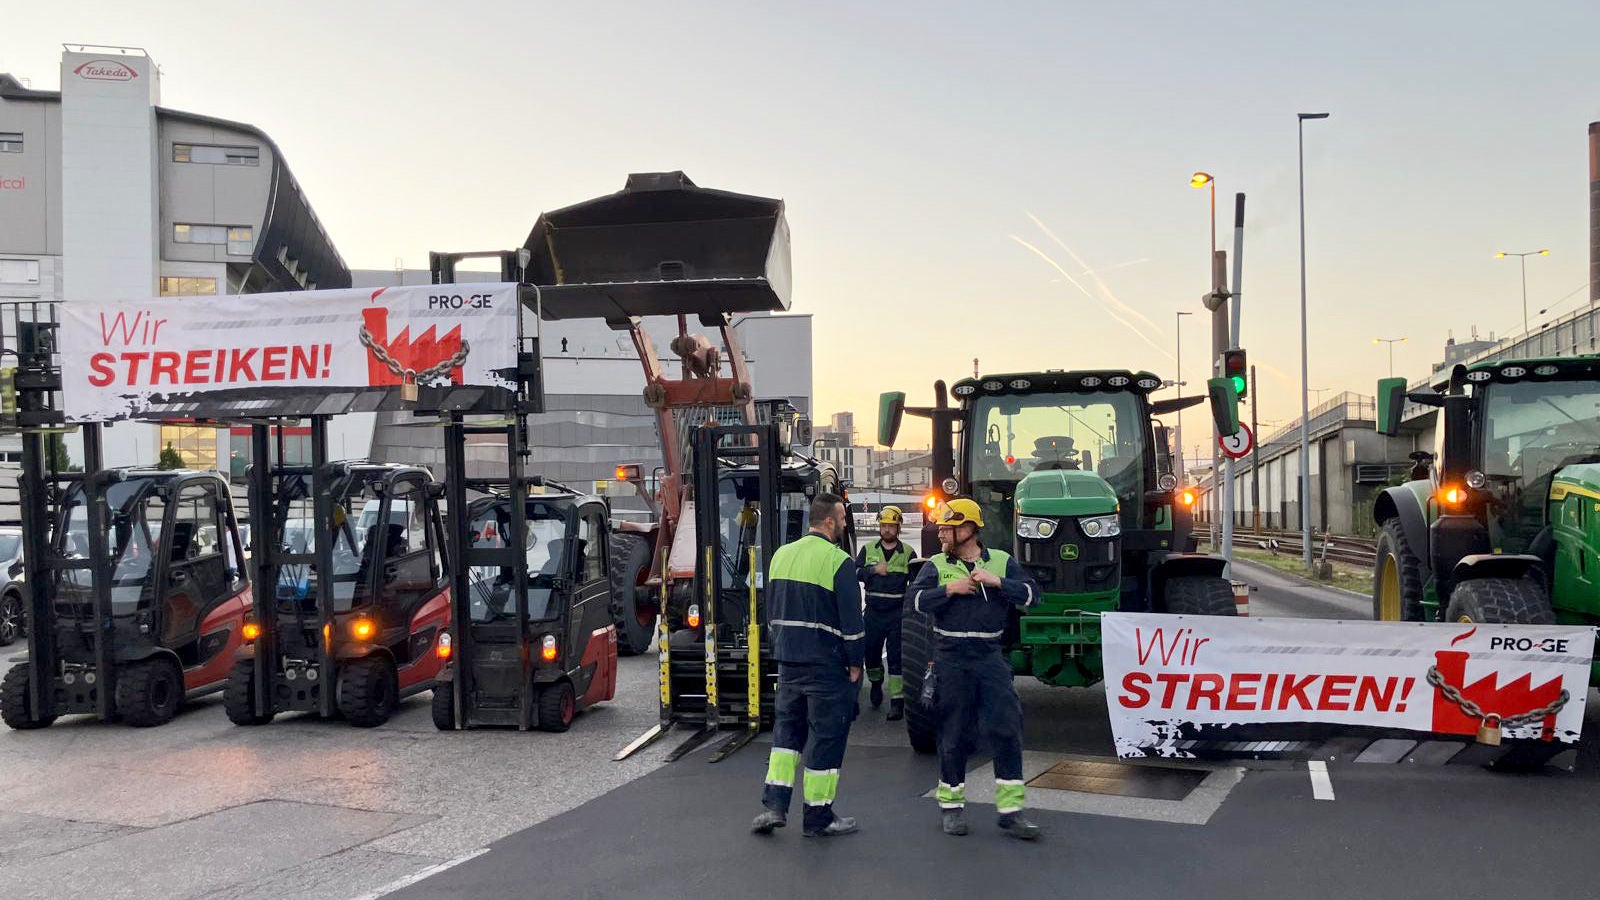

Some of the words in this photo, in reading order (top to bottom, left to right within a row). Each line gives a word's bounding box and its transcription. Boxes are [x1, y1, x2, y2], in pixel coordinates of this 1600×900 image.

[86, 66, 128, 77] Takeda
[100, 310, 167, 346] Wir
[88, 343, 333, 387] STREIKEN!
[1135, 627, 1210, 666] Wir
[1118, 671, 1416, 713] STREIKEN!
